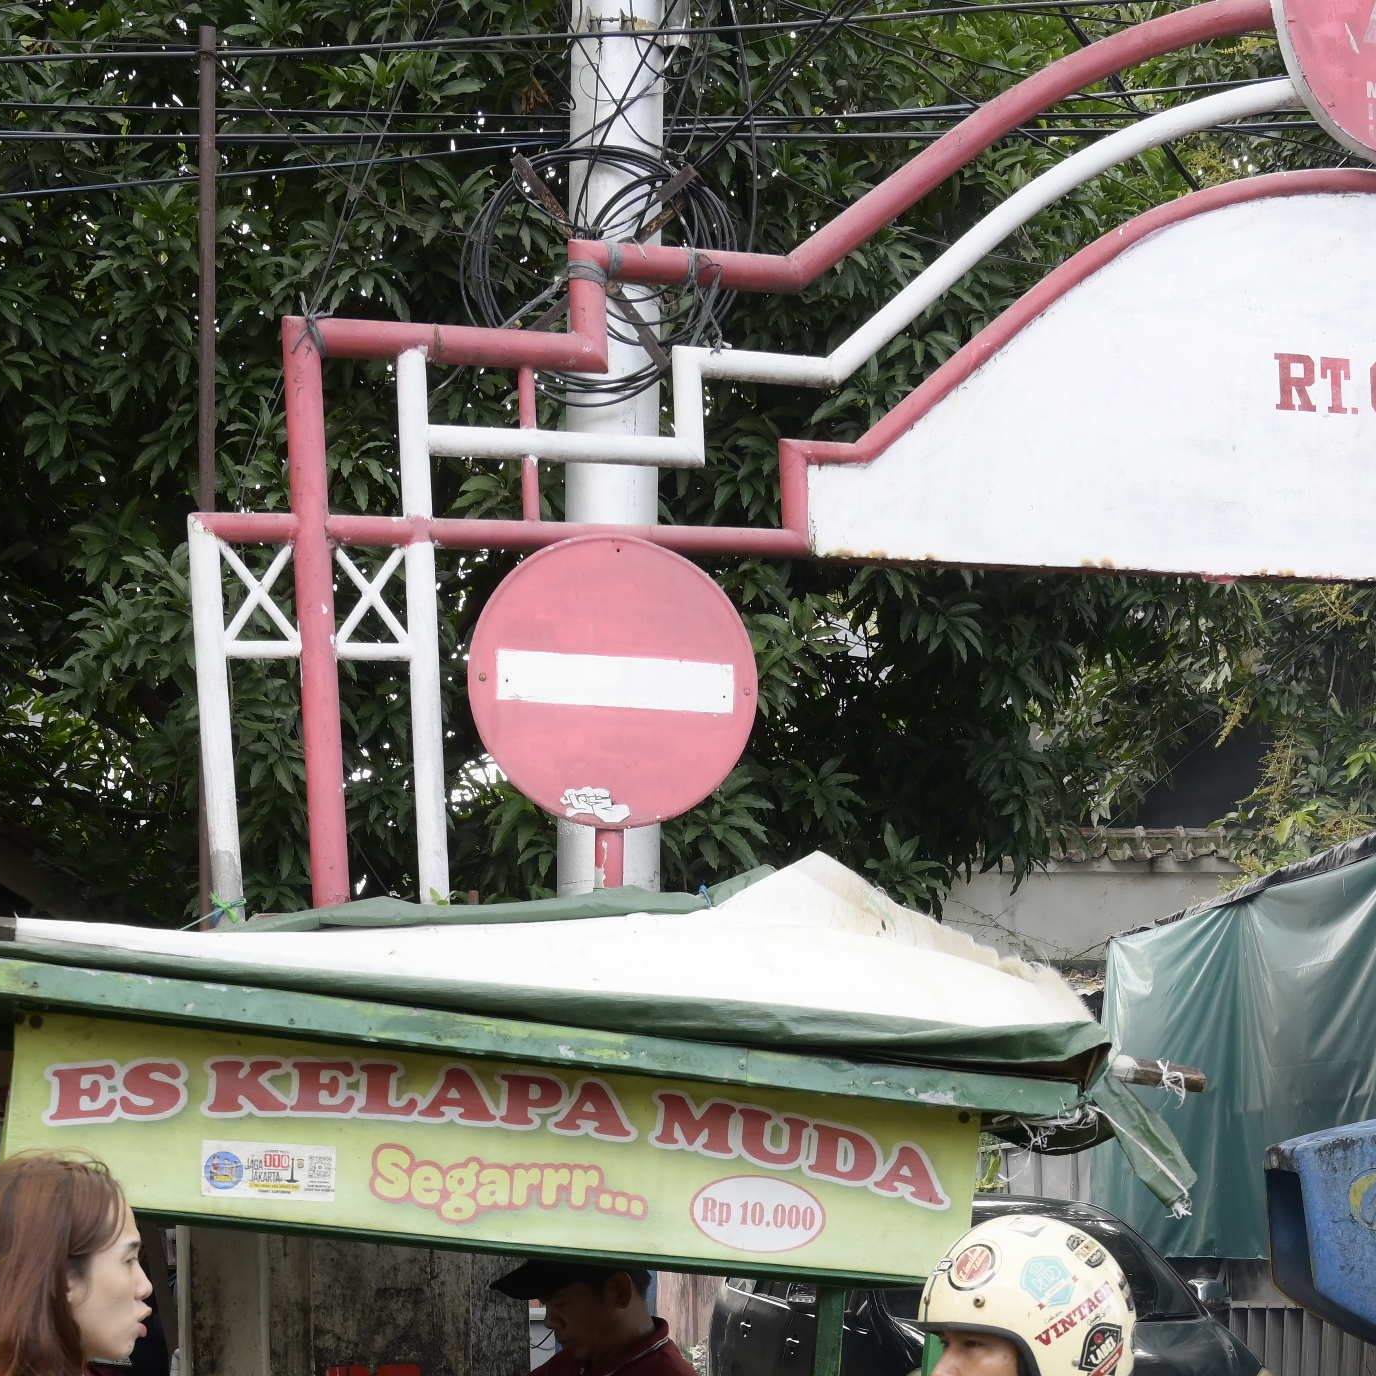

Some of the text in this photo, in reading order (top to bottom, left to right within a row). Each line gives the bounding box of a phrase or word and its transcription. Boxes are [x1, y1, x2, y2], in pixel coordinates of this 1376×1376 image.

[48, 1058, 952, 1209] ES KELAPA MUDA
[264, 1153, 289, 1168] 110
[372, 1144, 646, 1222] Segarrr...
[701, 1197, 816, 1234] Rp 10.000
[1034, 1281, 1114, 1347] VINTAGE
